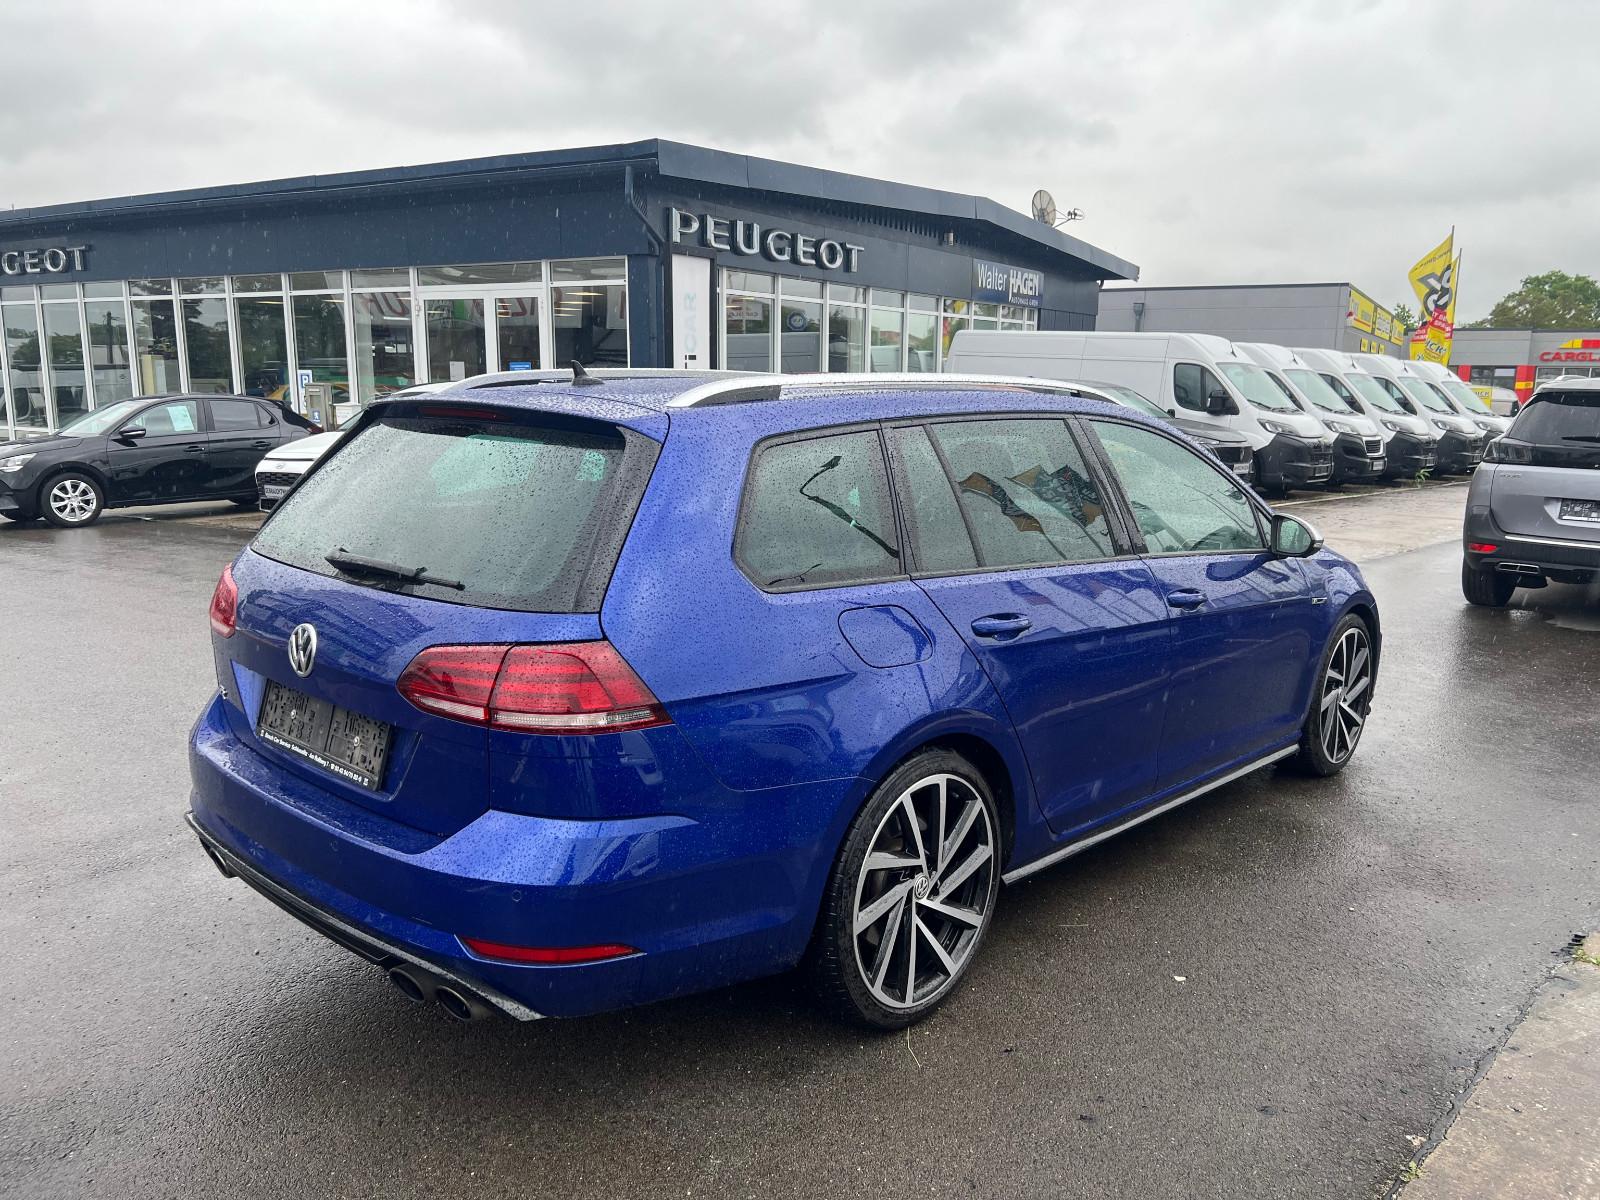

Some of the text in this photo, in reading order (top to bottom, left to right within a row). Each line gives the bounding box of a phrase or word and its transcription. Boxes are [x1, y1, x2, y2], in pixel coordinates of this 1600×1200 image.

[671, 207, 865, 272] PEUGEOT
[977, 263, 1040, 302] Walter HAGEN
[1538, 351, 1600, 363] CARGL
[288, 623, 317, 678] VW
